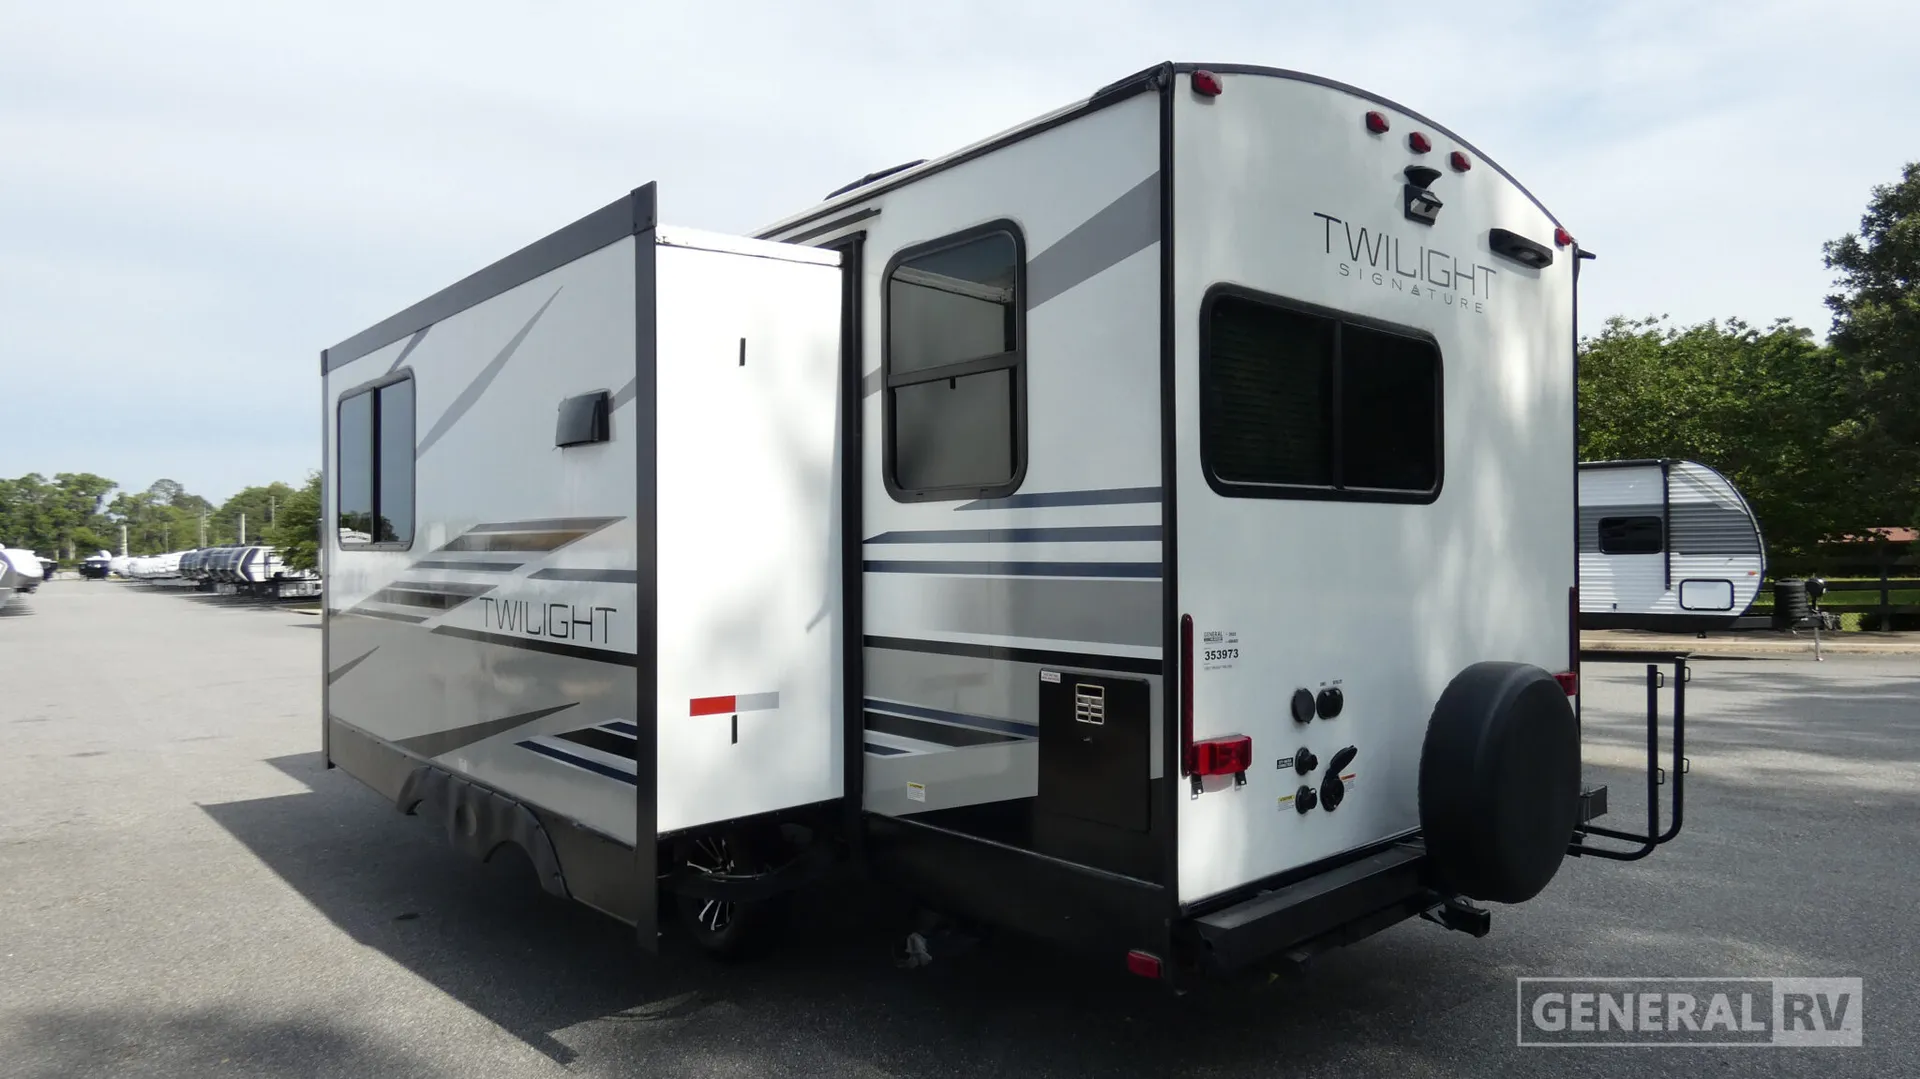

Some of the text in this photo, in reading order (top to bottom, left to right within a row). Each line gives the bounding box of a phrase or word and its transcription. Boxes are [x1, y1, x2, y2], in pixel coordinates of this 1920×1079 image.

[1313, 211, 1497, 300] TWILIGHT
[1338, 262, 1483, 314] SIGNATURE
[479, 596, 617, 644] TWILIGHT
[1204, 648, 1239, 661] 353973
